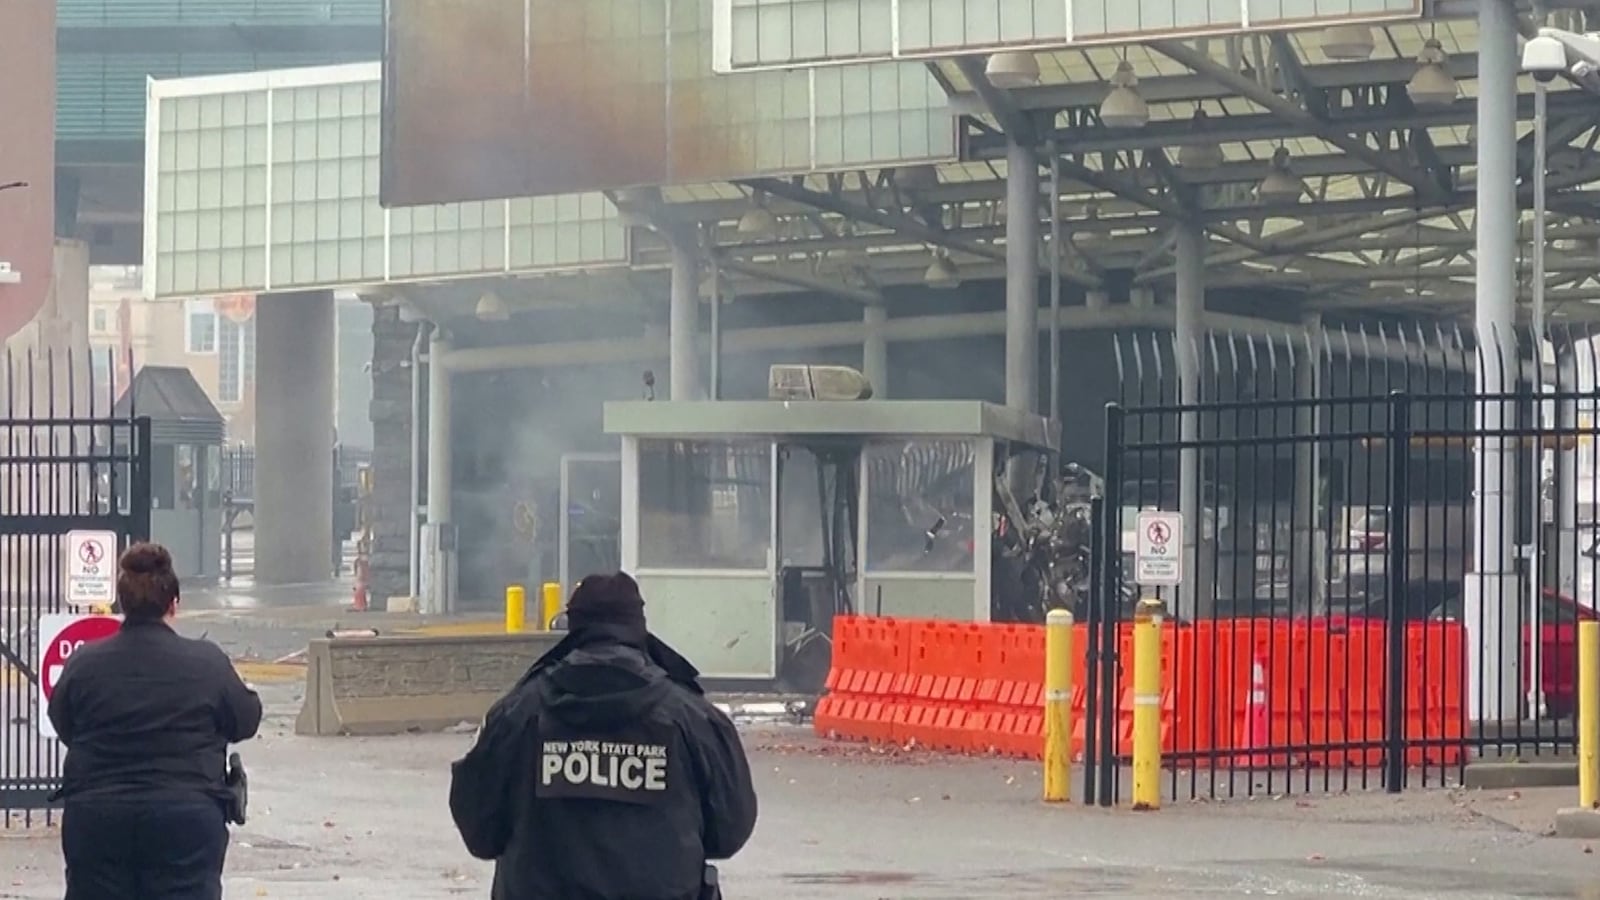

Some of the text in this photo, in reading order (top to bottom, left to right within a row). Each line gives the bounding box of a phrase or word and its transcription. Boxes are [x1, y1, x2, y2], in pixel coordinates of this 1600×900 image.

[1150, 546, 1167, 555] NO
[82, 566, 99, 574] NO
[543, 741, 666, 757] NEW YORK STATE PARK
[542, 753, 667, 790] POLICE
